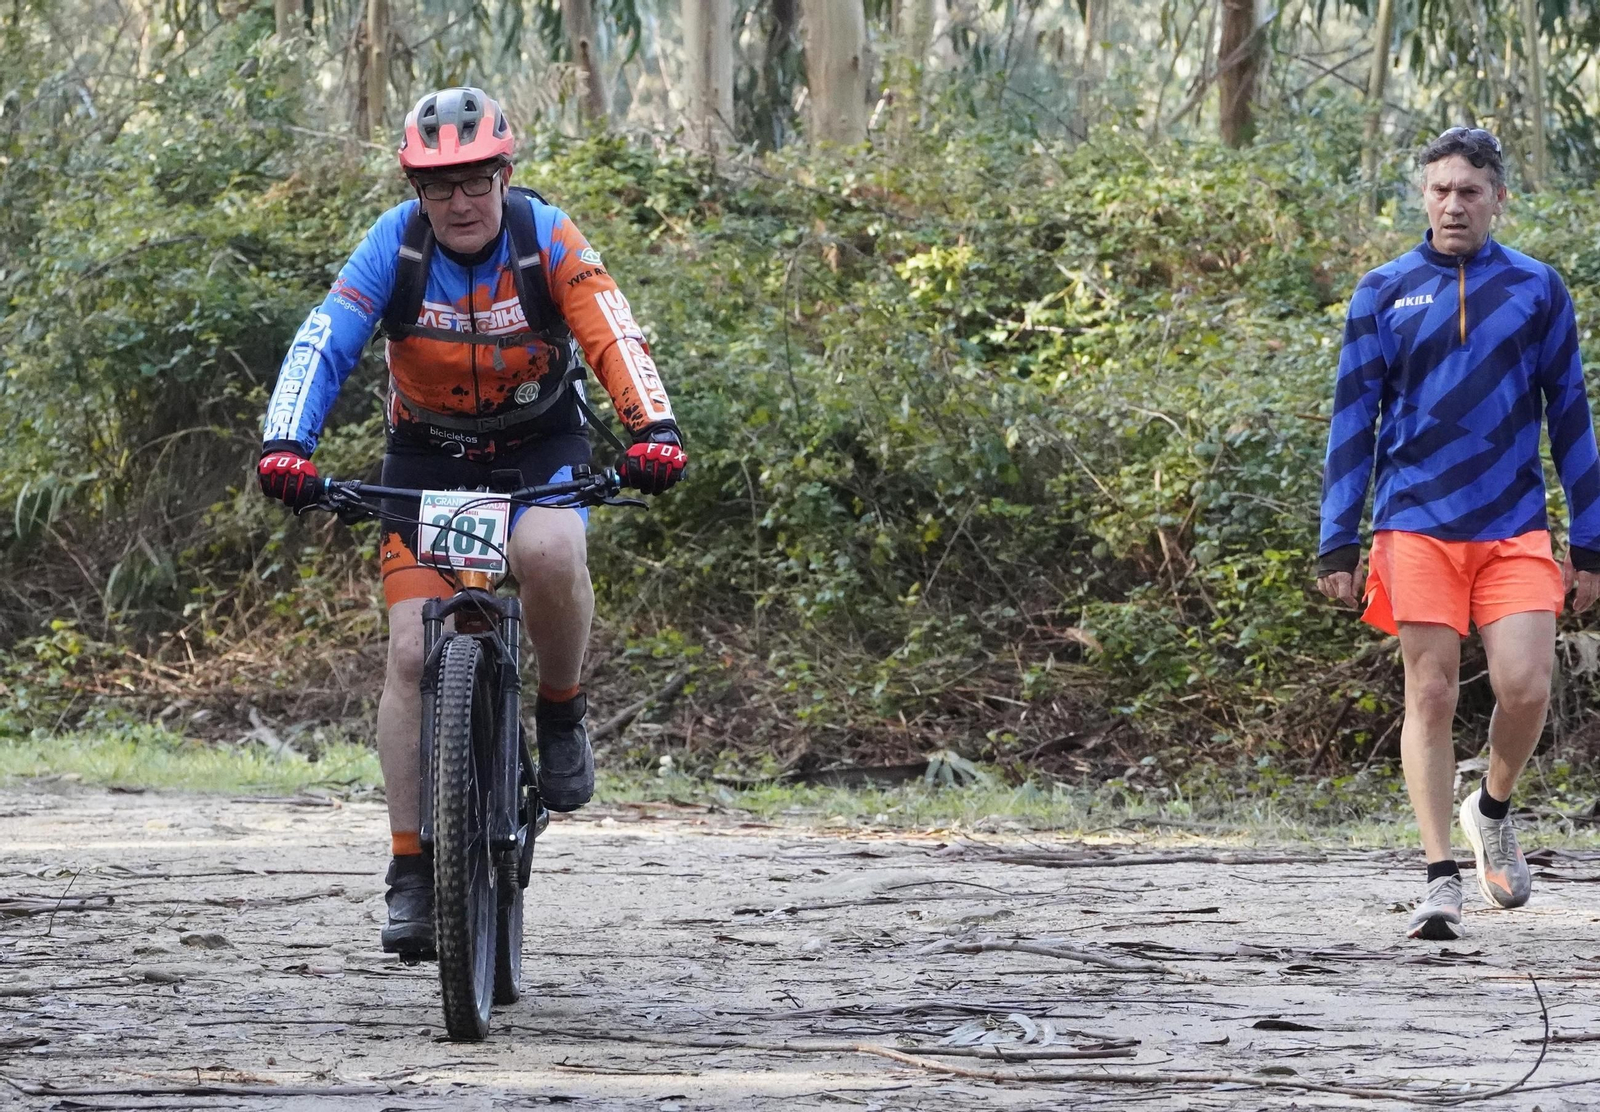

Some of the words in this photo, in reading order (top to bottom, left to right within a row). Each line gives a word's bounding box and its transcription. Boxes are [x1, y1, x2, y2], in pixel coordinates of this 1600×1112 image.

[567, 270, 593, 288] YVES
[1394, 294, 1434, 309] BIKILA
[429, 426, 478, 444] bicicletas
[647, 442, 685, 462] FOX
[263, 457, 305, 470] FOX
[425, 497, 432, 505] A
[434, 496, 459, 506] GRAN
[430, 514, 497, 556] 287
